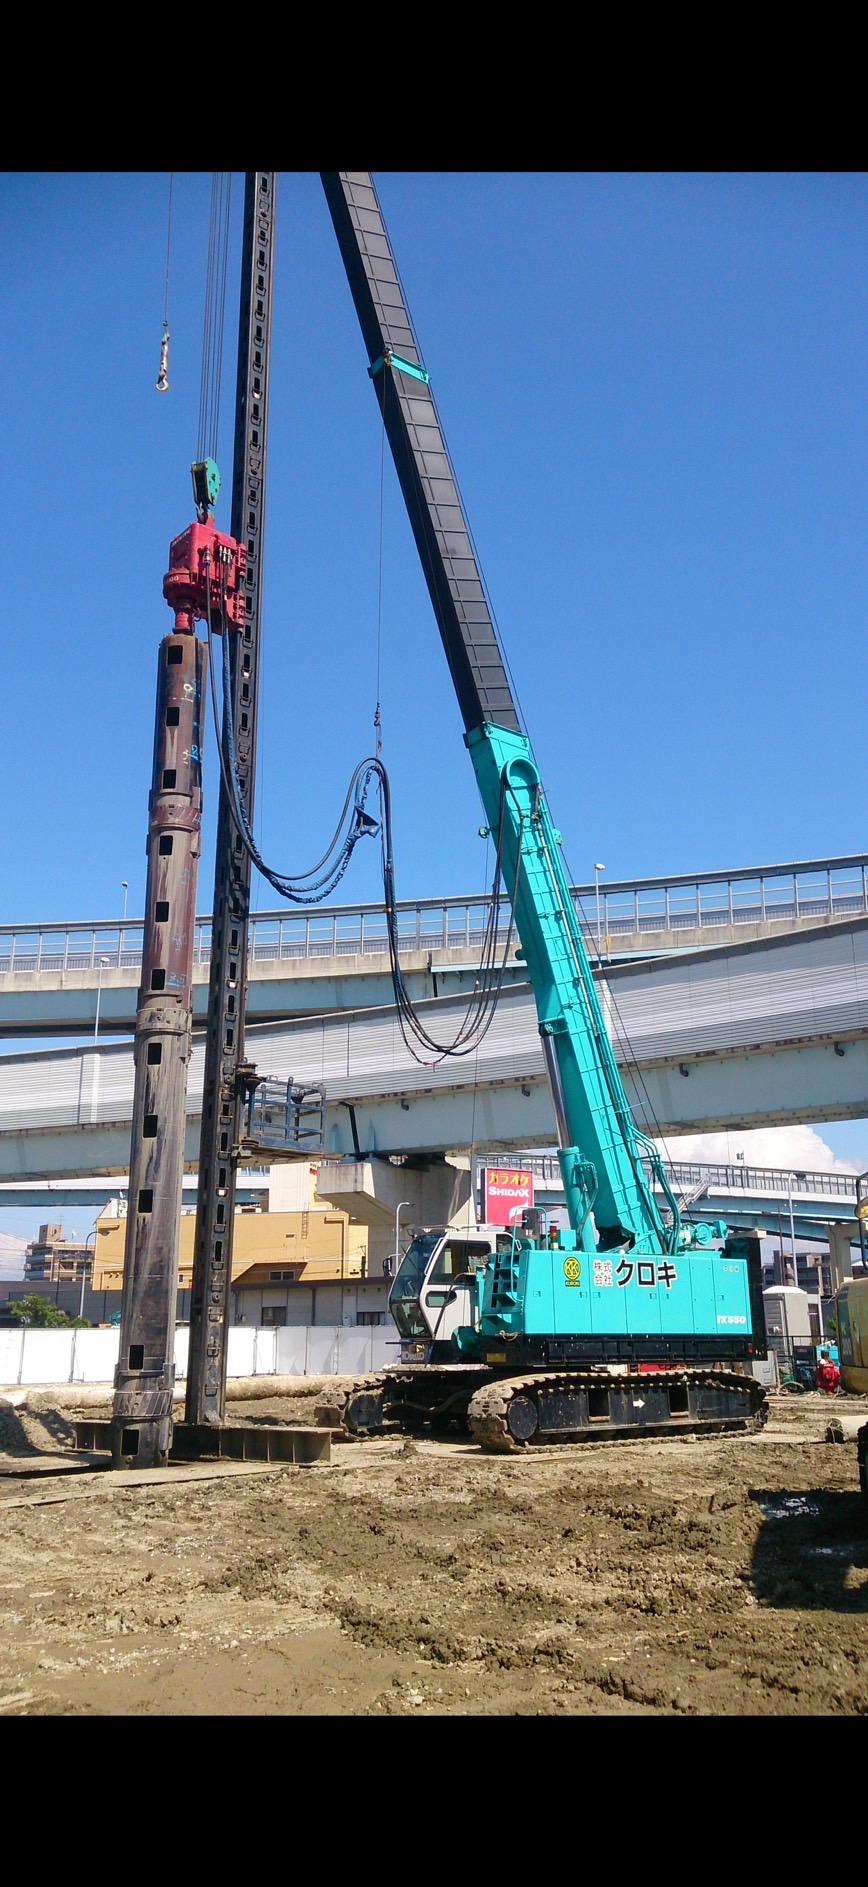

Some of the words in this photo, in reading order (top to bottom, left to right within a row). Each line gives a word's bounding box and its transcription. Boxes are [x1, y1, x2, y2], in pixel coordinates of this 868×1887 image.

[489, 1172, 530, 1186] カラオケ
[488, 1186, 530, 1198] SHIDAX
[616, 1259, 677, 1288] クロキ
